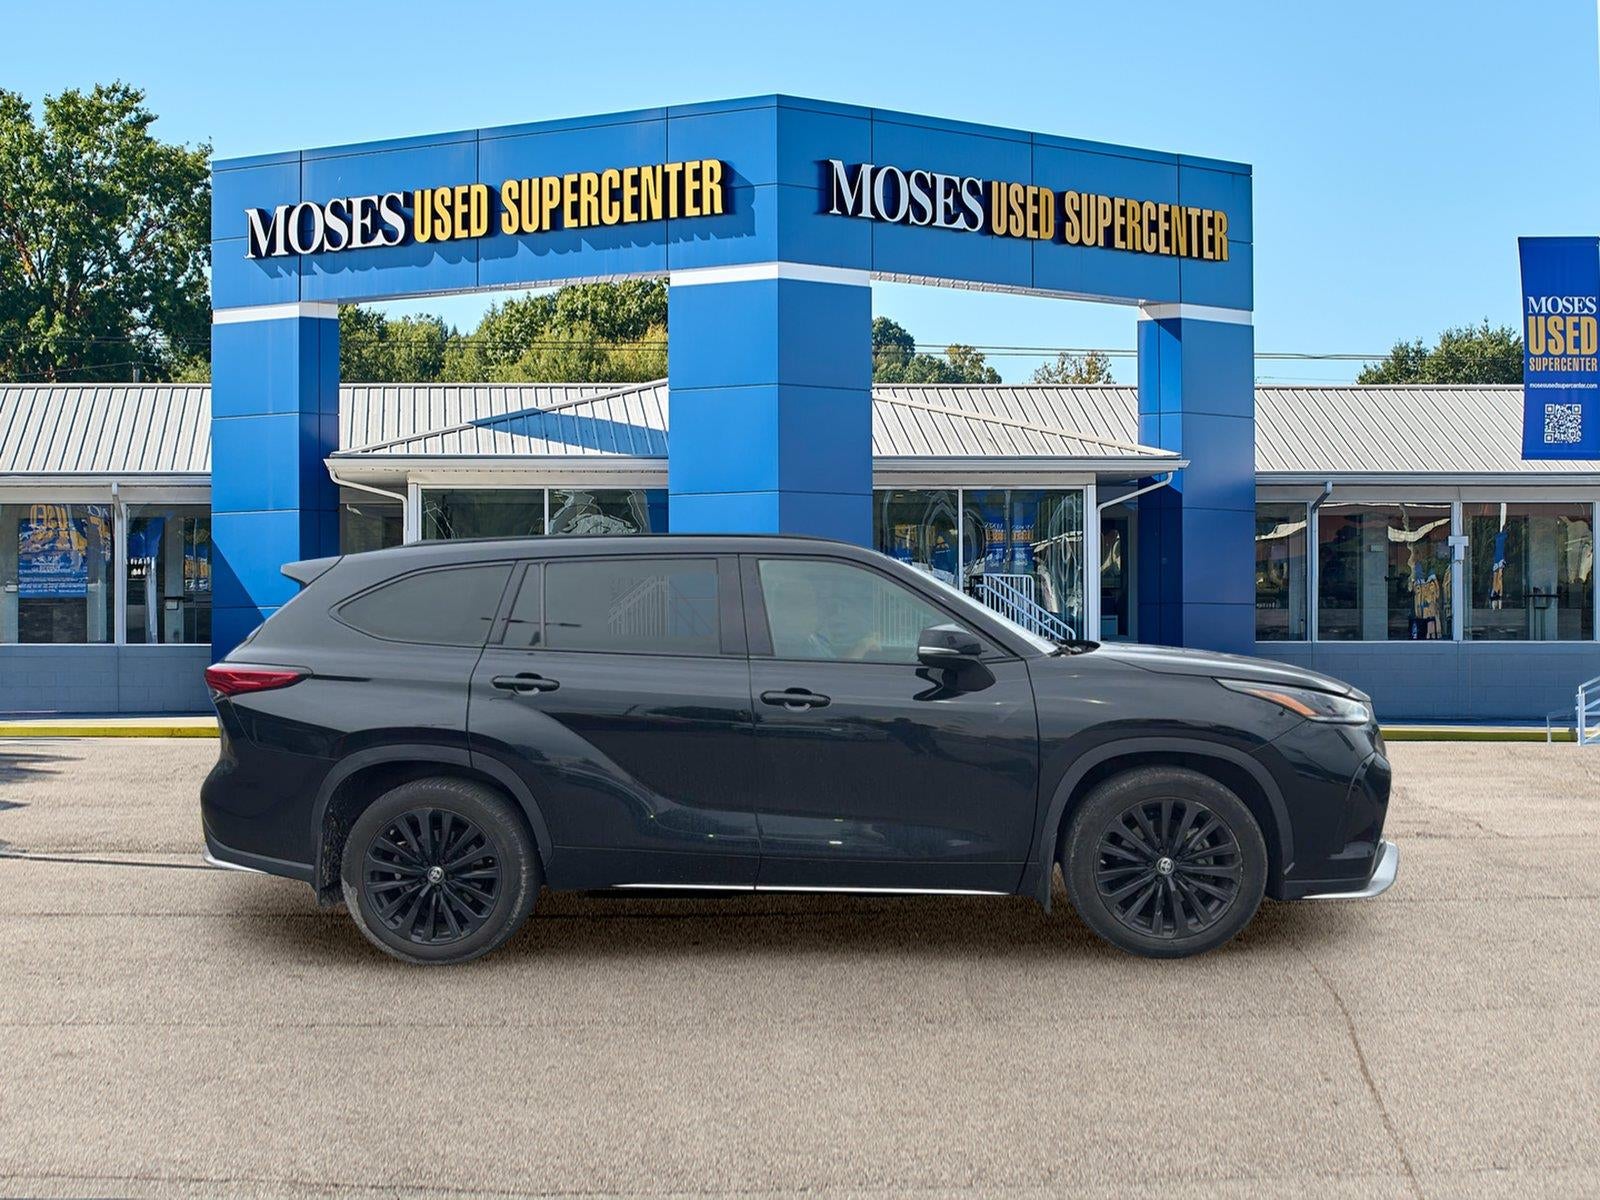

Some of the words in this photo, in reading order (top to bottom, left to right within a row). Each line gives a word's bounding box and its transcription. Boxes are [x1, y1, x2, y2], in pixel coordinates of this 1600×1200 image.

[244, 192, 407, 259] MOSES
[413, 184, 489, 243] USED
[501, 159, 723, 235] SUPERCENTER
[828, 158, 984, 232] MOSES
[991, 180, 1055, 240] USED
[1064, 190, 1229, 262] SUPERCENTER
[1527, 296, 1597, 314] MOSES
[1528, 316, 1598, 355] USED
[1529, 357, 1598, 372] SUPERCENTER
